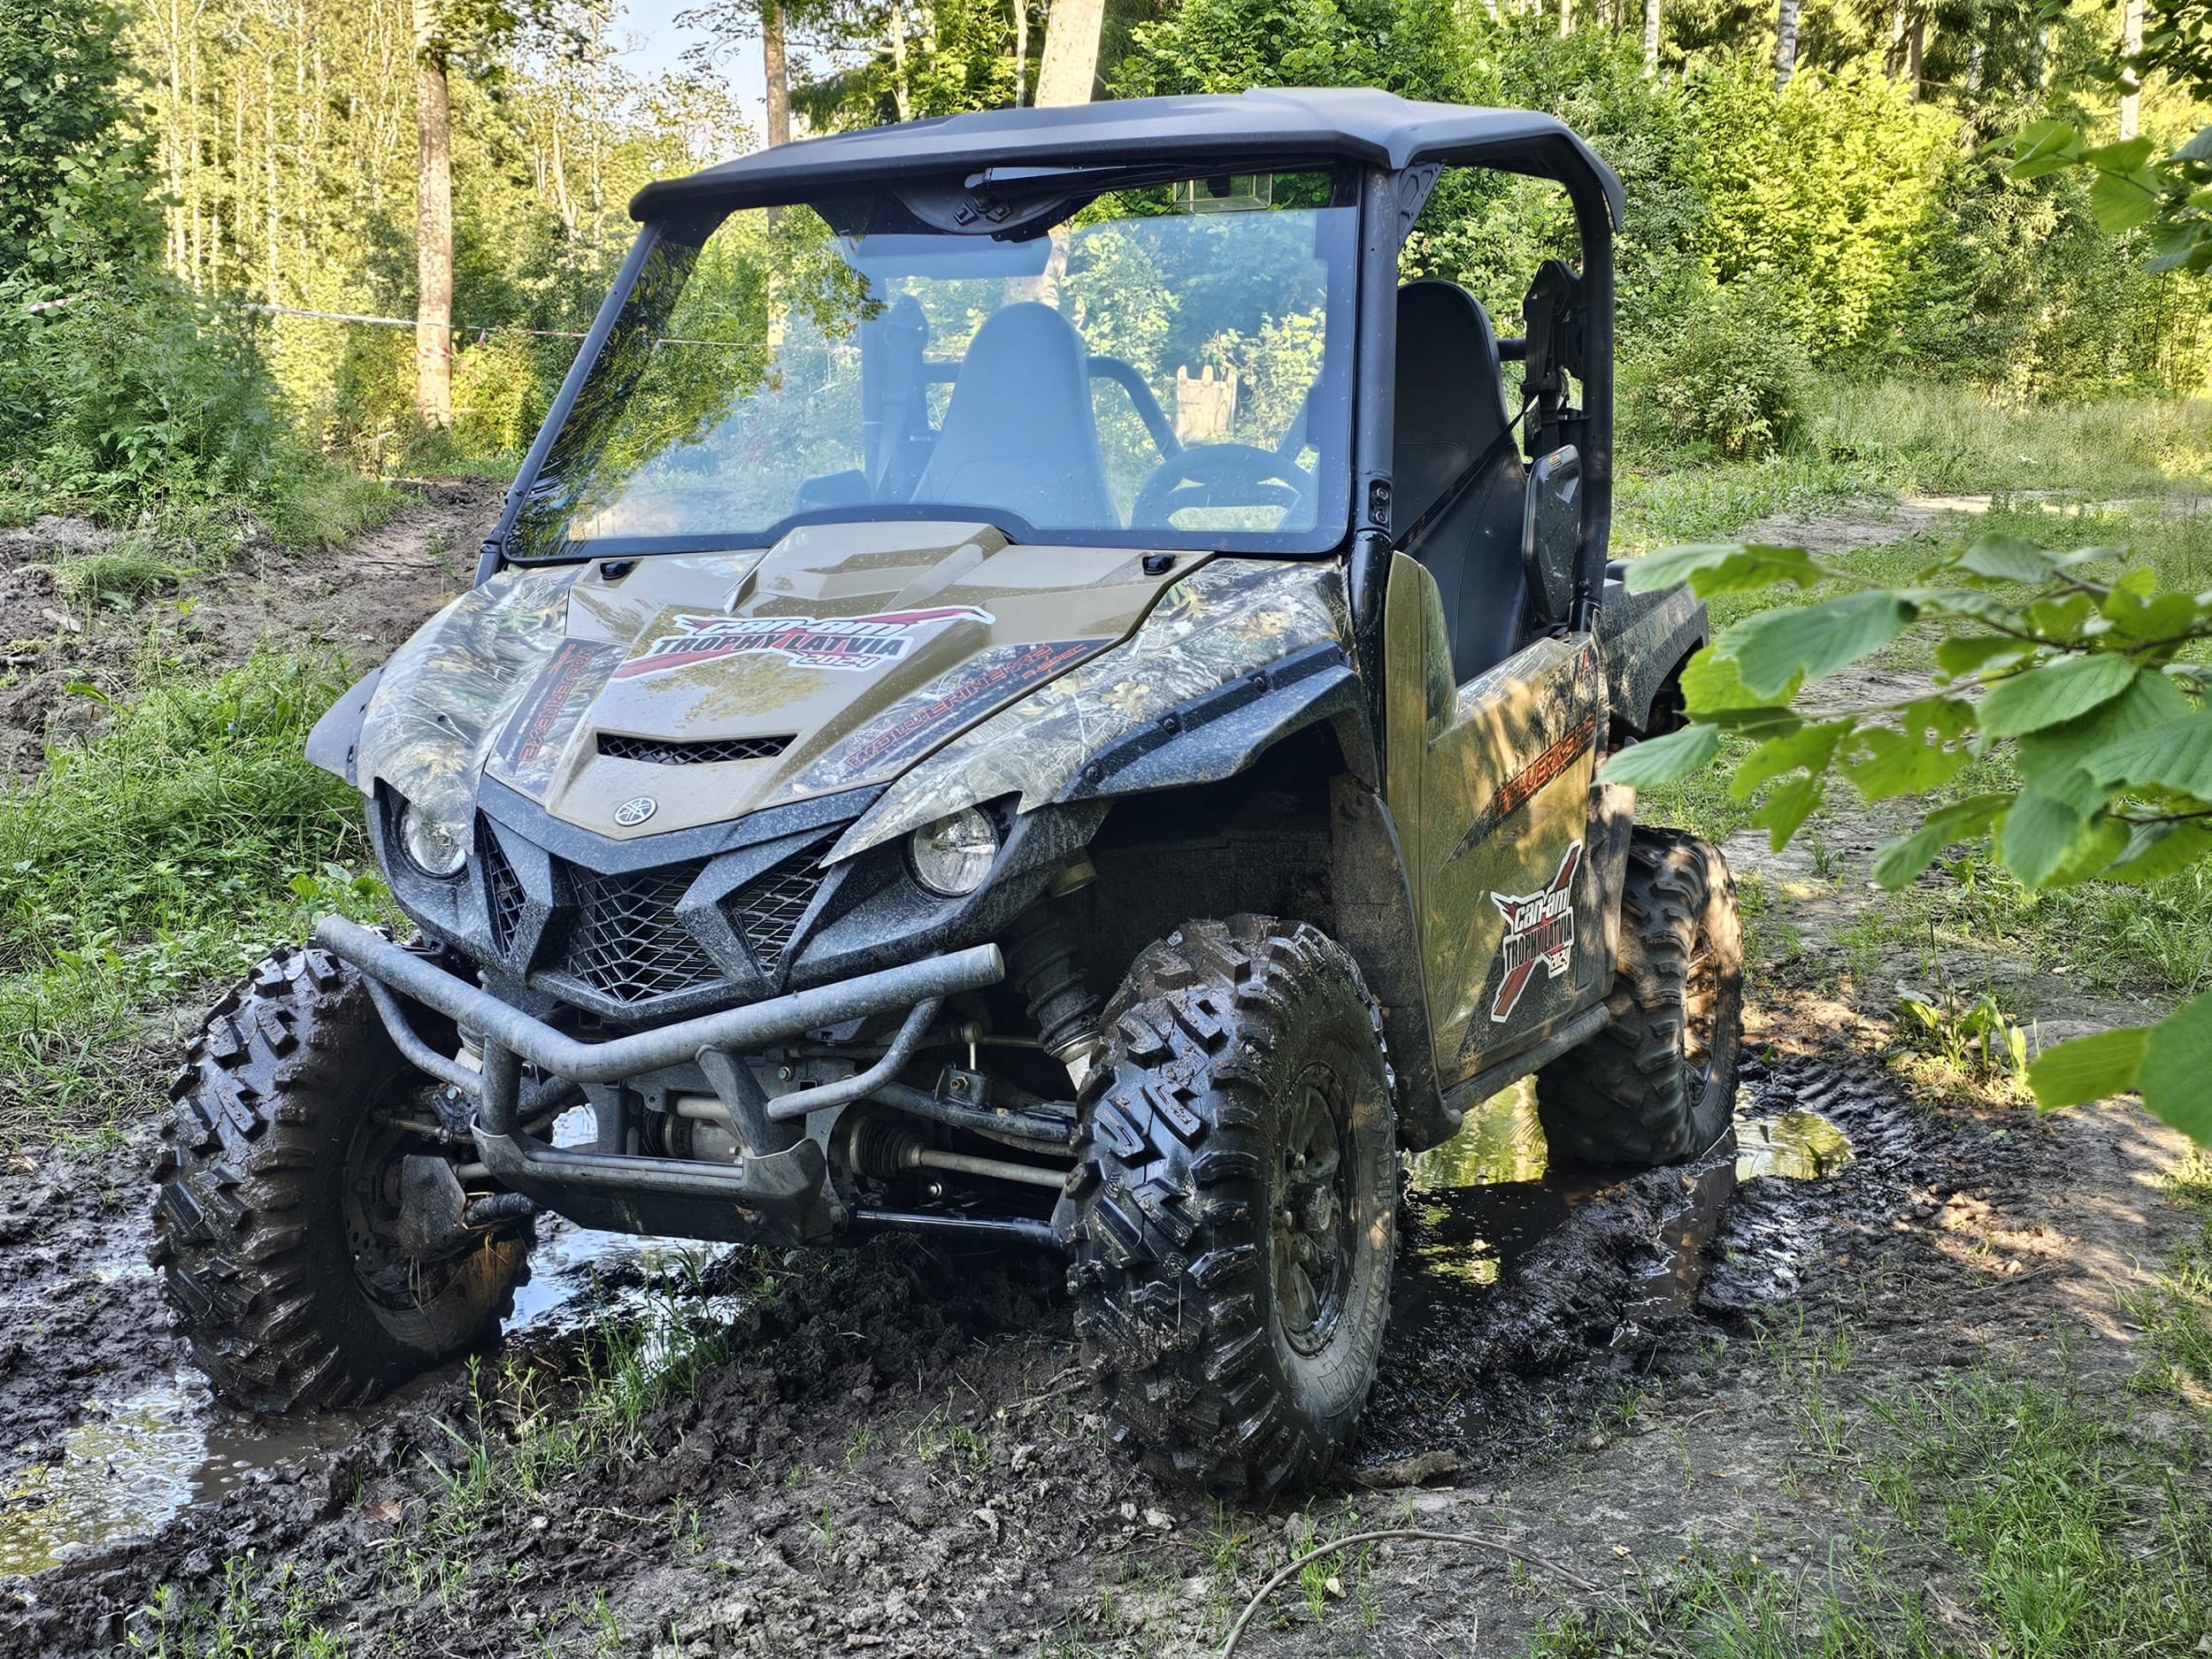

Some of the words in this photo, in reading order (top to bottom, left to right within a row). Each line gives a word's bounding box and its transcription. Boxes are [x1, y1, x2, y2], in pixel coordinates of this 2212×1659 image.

[654, 634, 785, 655] TROPHY
[784, 634, 905, 656] LATVIA
[797, 653, 879, 668] 2024
[1505, 926, 1542, 973] TROPHY
[1542, 912, 1572, 954] LATVIA
